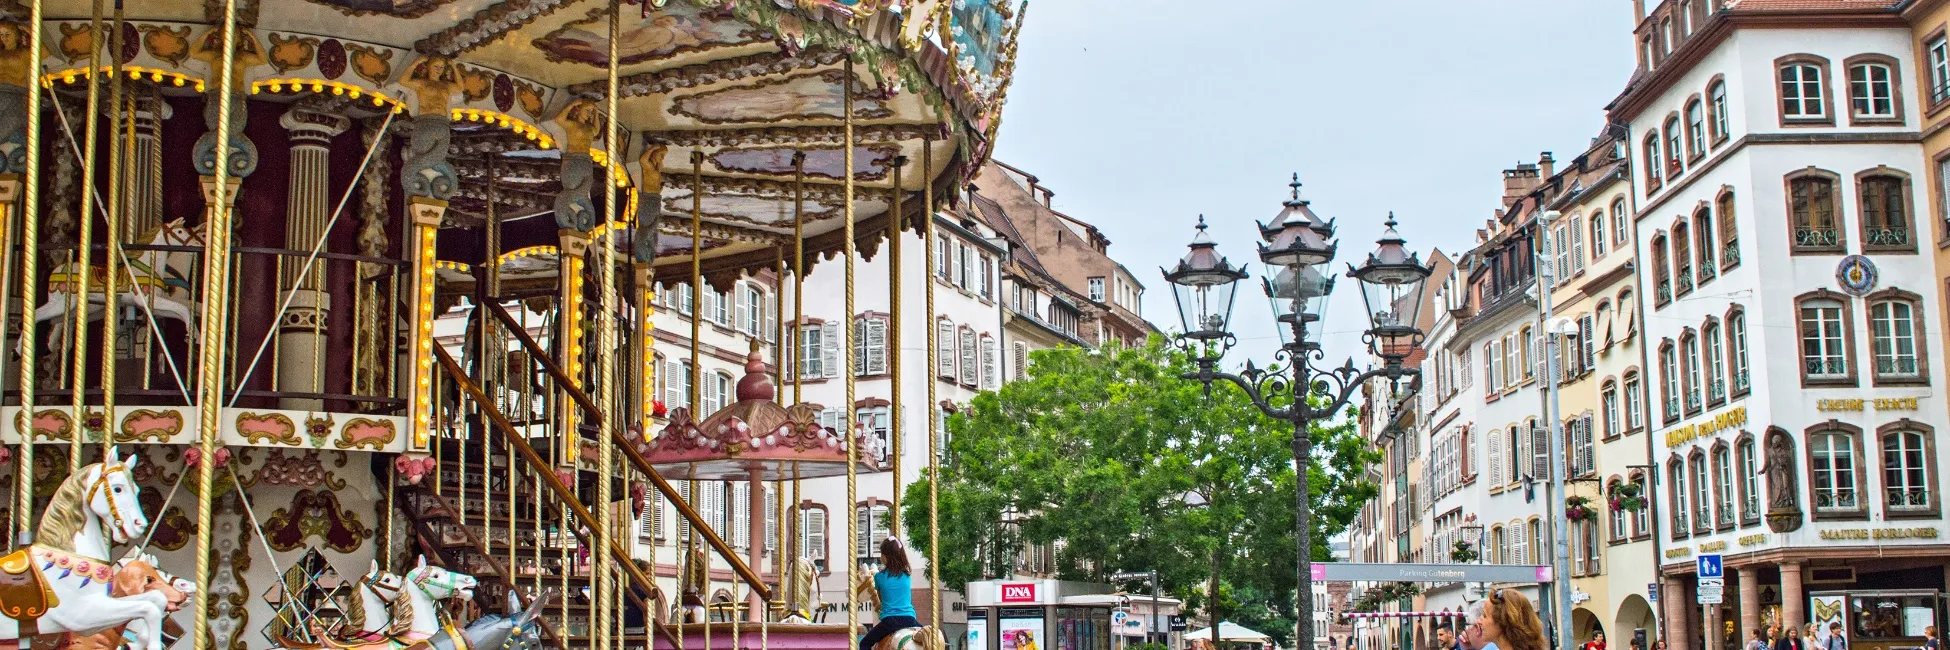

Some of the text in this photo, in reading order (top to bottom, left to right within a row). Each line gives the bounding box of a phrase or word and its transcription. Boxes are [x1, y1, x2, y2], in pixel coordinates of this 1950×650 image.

[1872, 527, 1938, 539] HORLOGER
[1400, 569, 1465, 579] Parking Gutenberg
[1005, 587, 1032, 597] DNA
